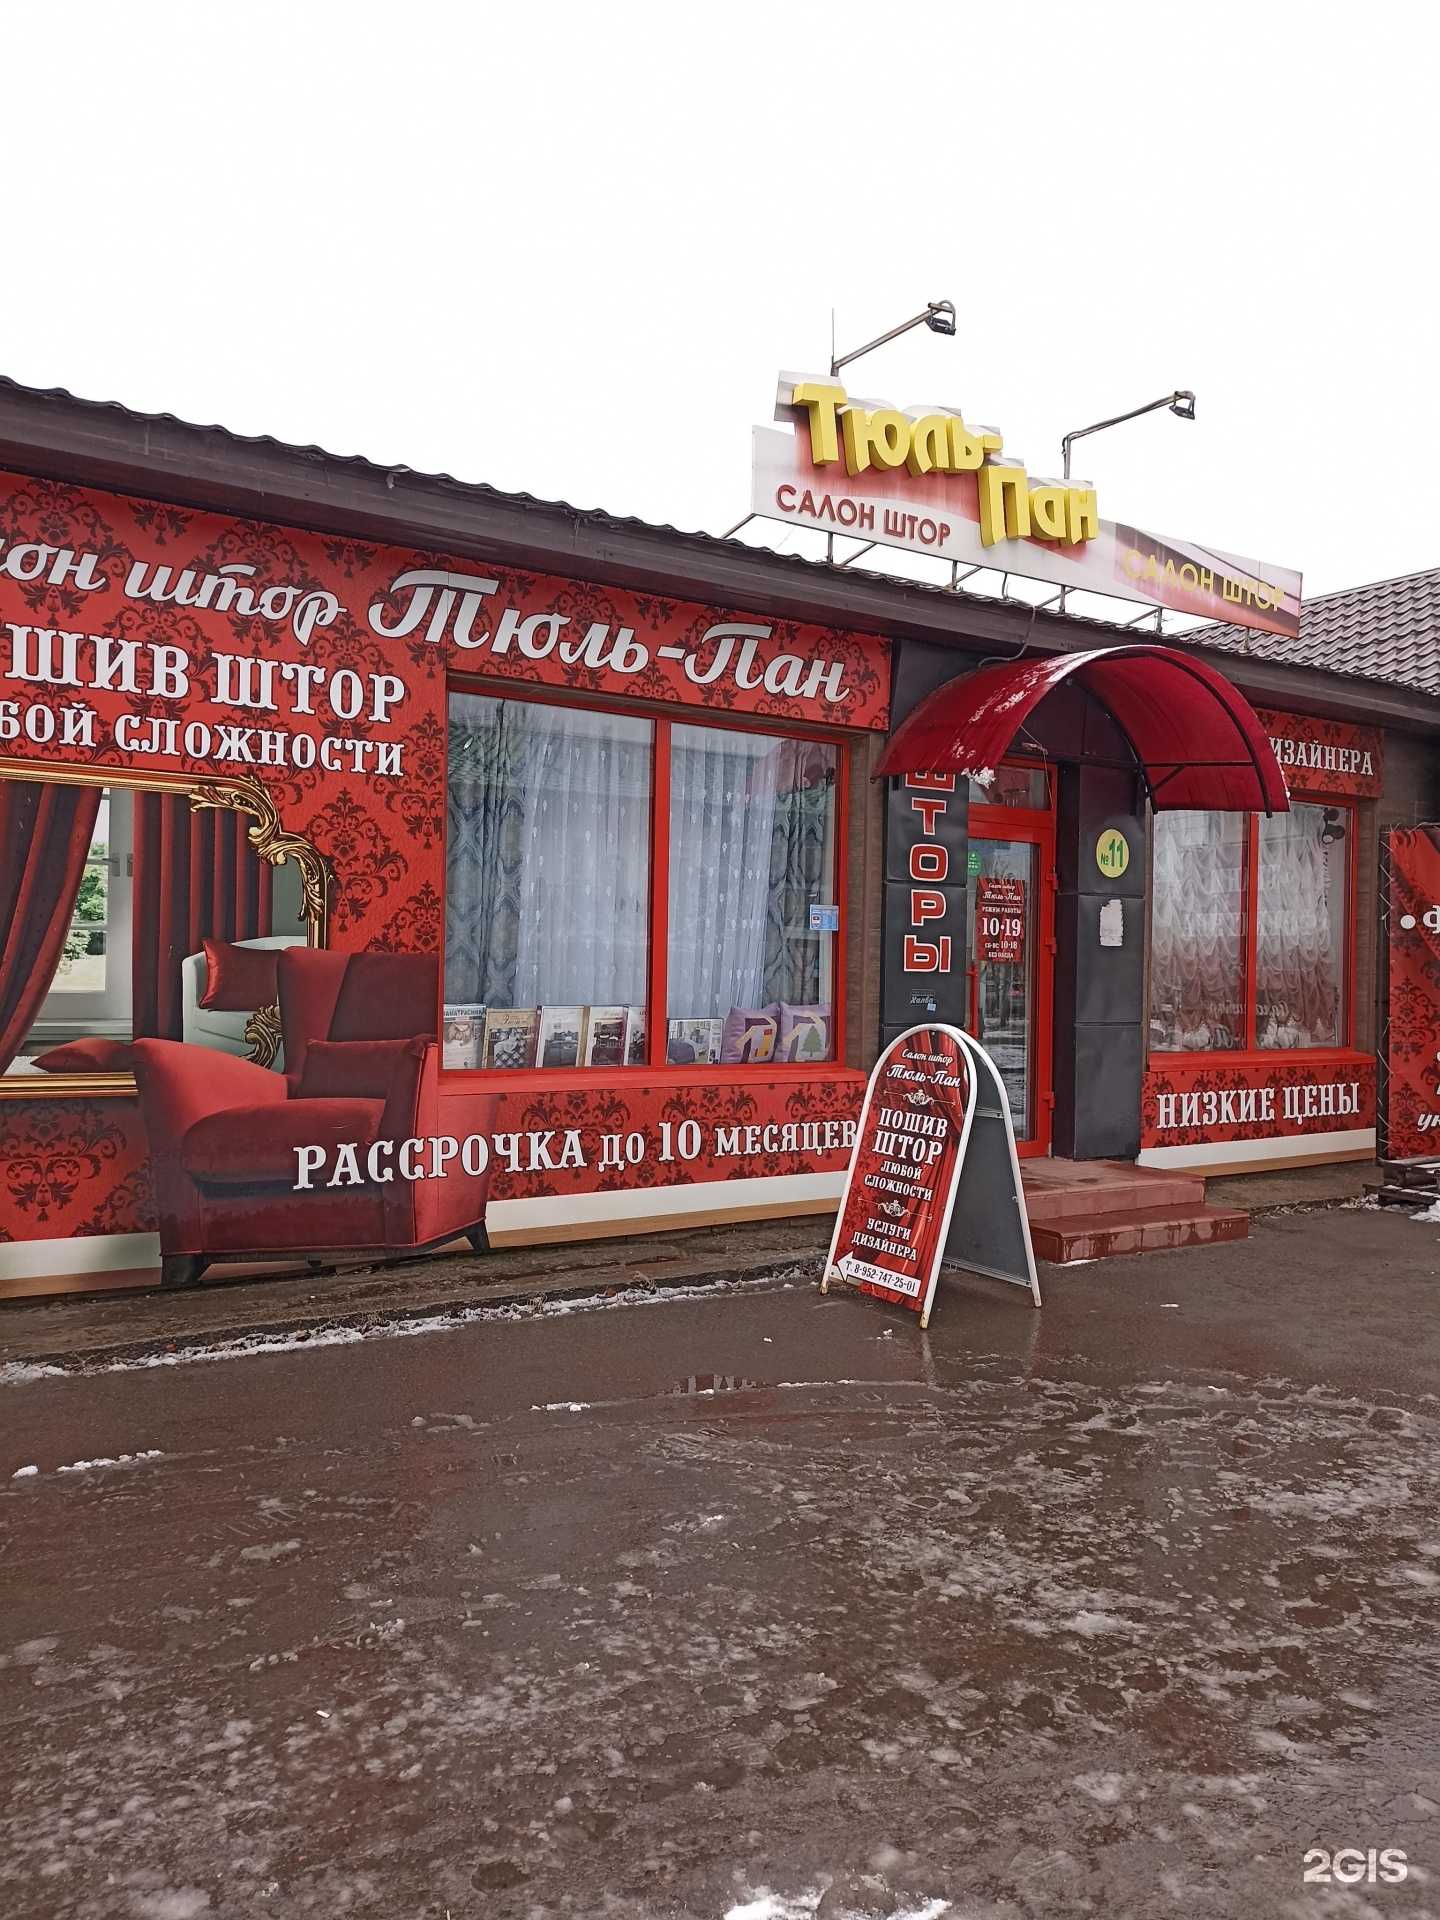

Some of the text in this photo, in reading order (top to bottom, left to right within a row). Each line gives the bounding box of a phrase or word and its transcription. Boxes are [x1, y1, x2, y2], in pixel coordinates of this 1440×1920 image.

[776, 484, 951, 547] САЛОН ШТОР
[976, 464, 1097, 549] Пан
[1122, 548, 1286, 612] САЛОН ШТОР
[124, 561, 347, 646] штор
[367, 569, 850, 704] Тюль-Пан
[4, 622, 405, 763] ШИВ ШТОР
[114, 714, 405, 777] СЛОЖНОСТИ
[902, 1048, 954, 1066] Салон штор
[886, 1064, 961, 1088] Тюль-Пан
[878, 1107, 948, 1138] ПОШИВ
[1156, 1082, 1360, 1129] НИЗКИЕ ЦЕНЫ
[292, 1129, 587, 1190] РАССРОЧКА
[658, 1119, 702, 1161] 10
[872, 1129, 943, 1165] ШТОР
[864, 1174, 933, 1201] СЛОЖНОСТИ
[880, 1160, 923, 1180] ЛЮБОЙ
[851, 1231, 917, 1261] ДИЗАЙНЕРА
[866, 1217, 912, 1240] УСЛУГИ
[854, 1263, 916, 1293] 8-952-747-25-01
